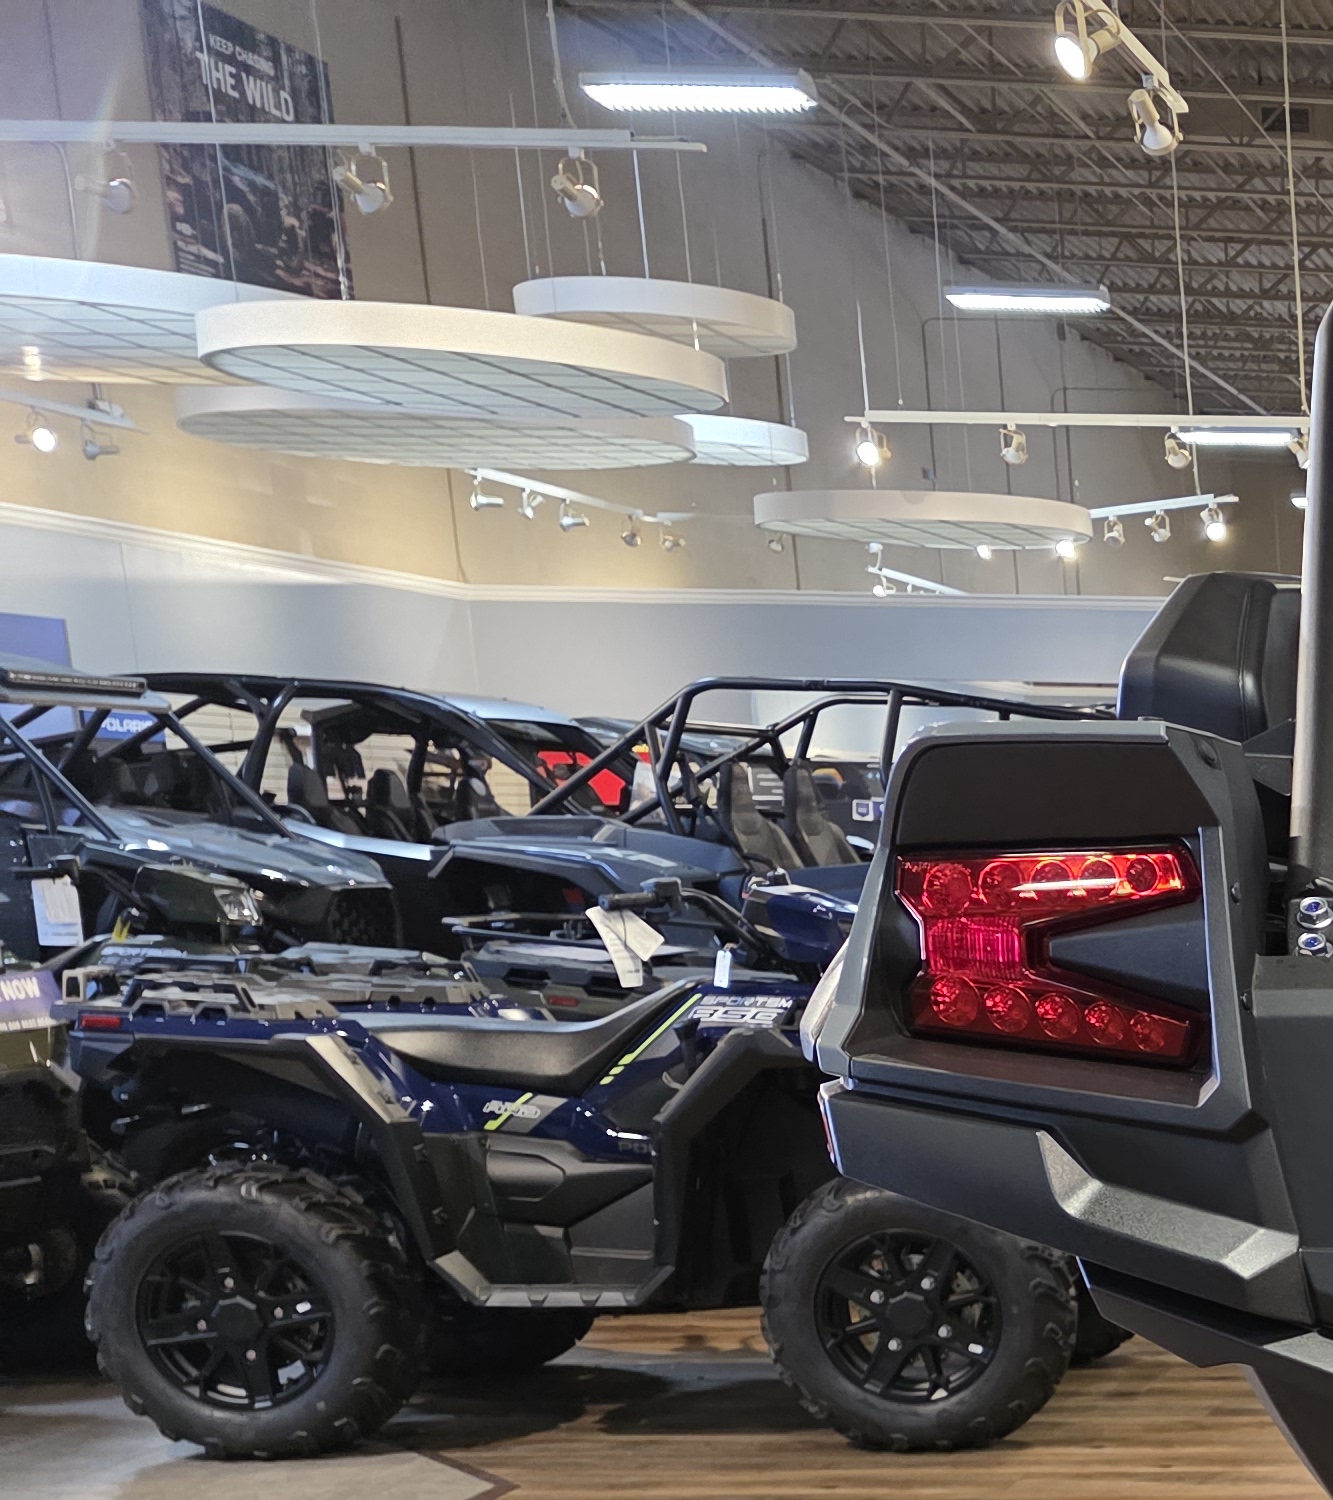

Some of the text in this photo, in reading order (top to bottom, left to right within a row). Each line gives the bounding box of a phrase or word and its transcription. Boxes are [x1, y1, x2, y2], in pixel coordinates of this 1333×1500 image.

[208, 33, 275, 77] KEEP CHASING
[195, 50, 295, 122] THE WILD
[1, 976, 42, 1001] NOW
